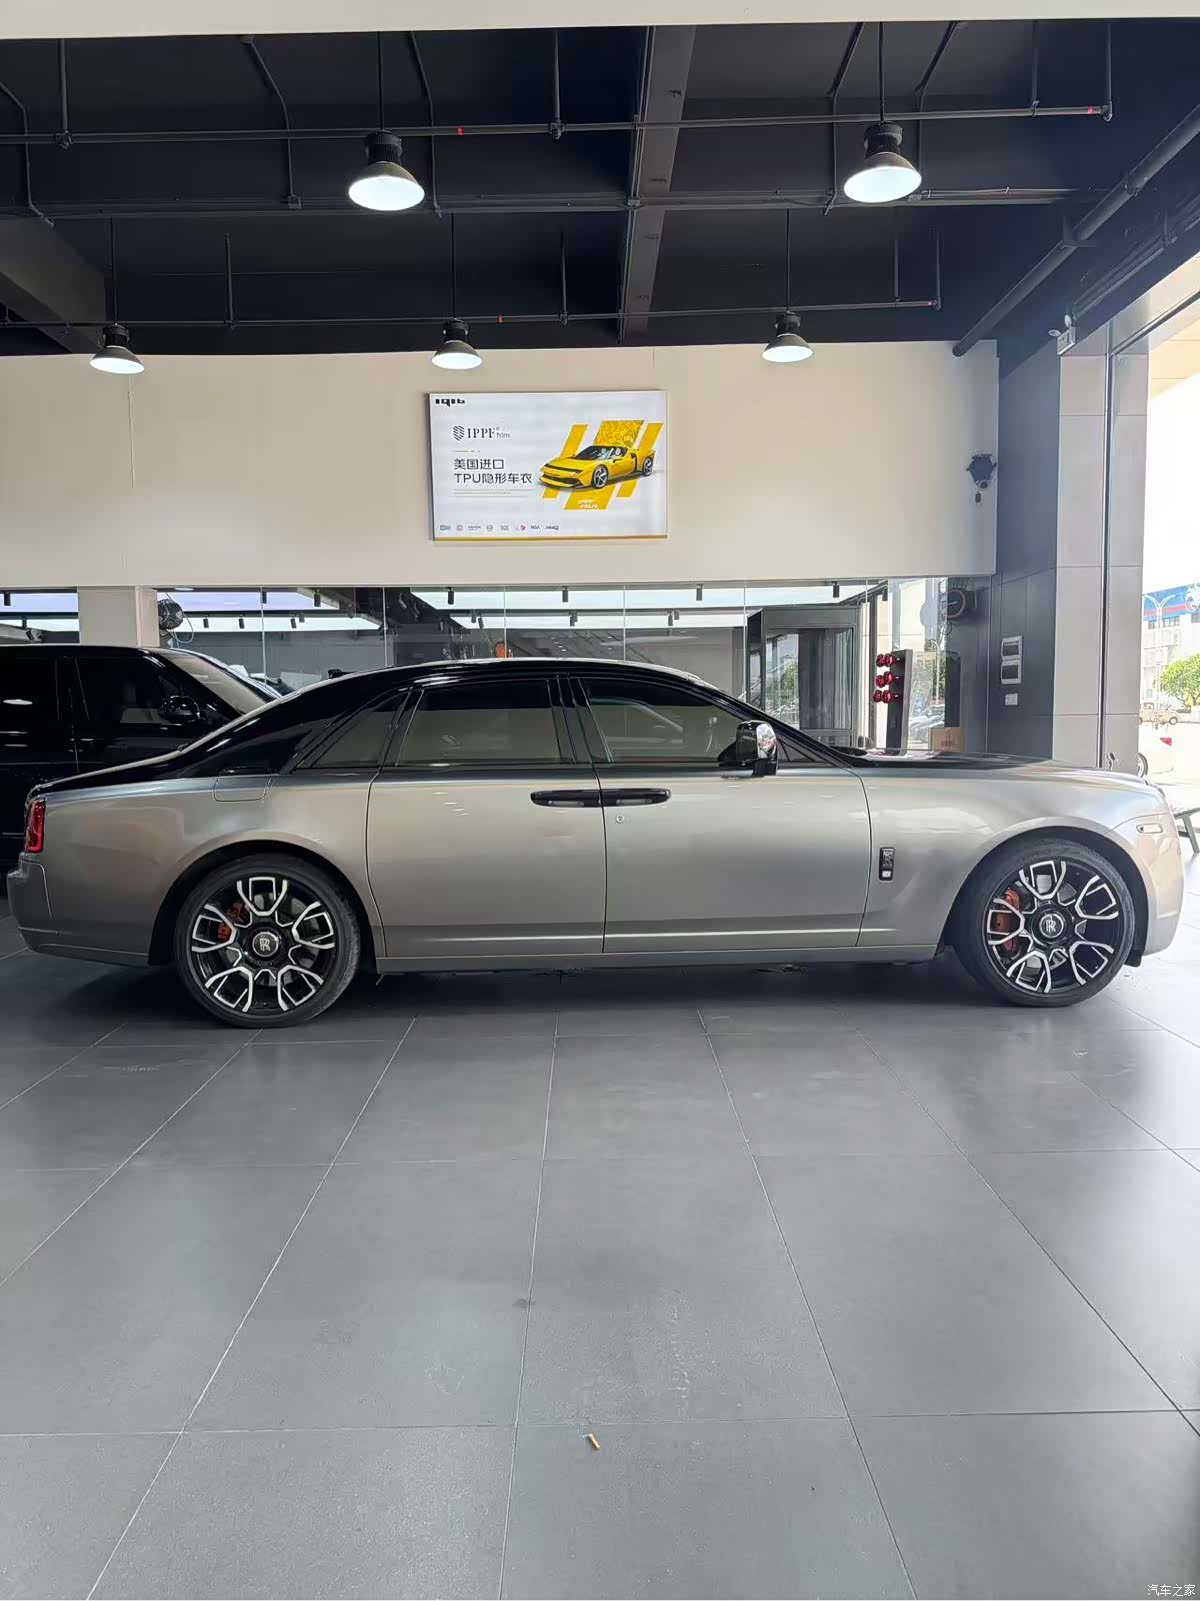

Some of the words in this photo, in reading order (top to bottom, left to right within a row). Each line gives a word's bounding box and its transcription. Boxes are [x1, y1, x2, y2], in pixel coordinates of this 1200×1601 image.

[454, 459, 504, 470] 美国进口
[454, 473, 532, 484] TPU隐形车衣
